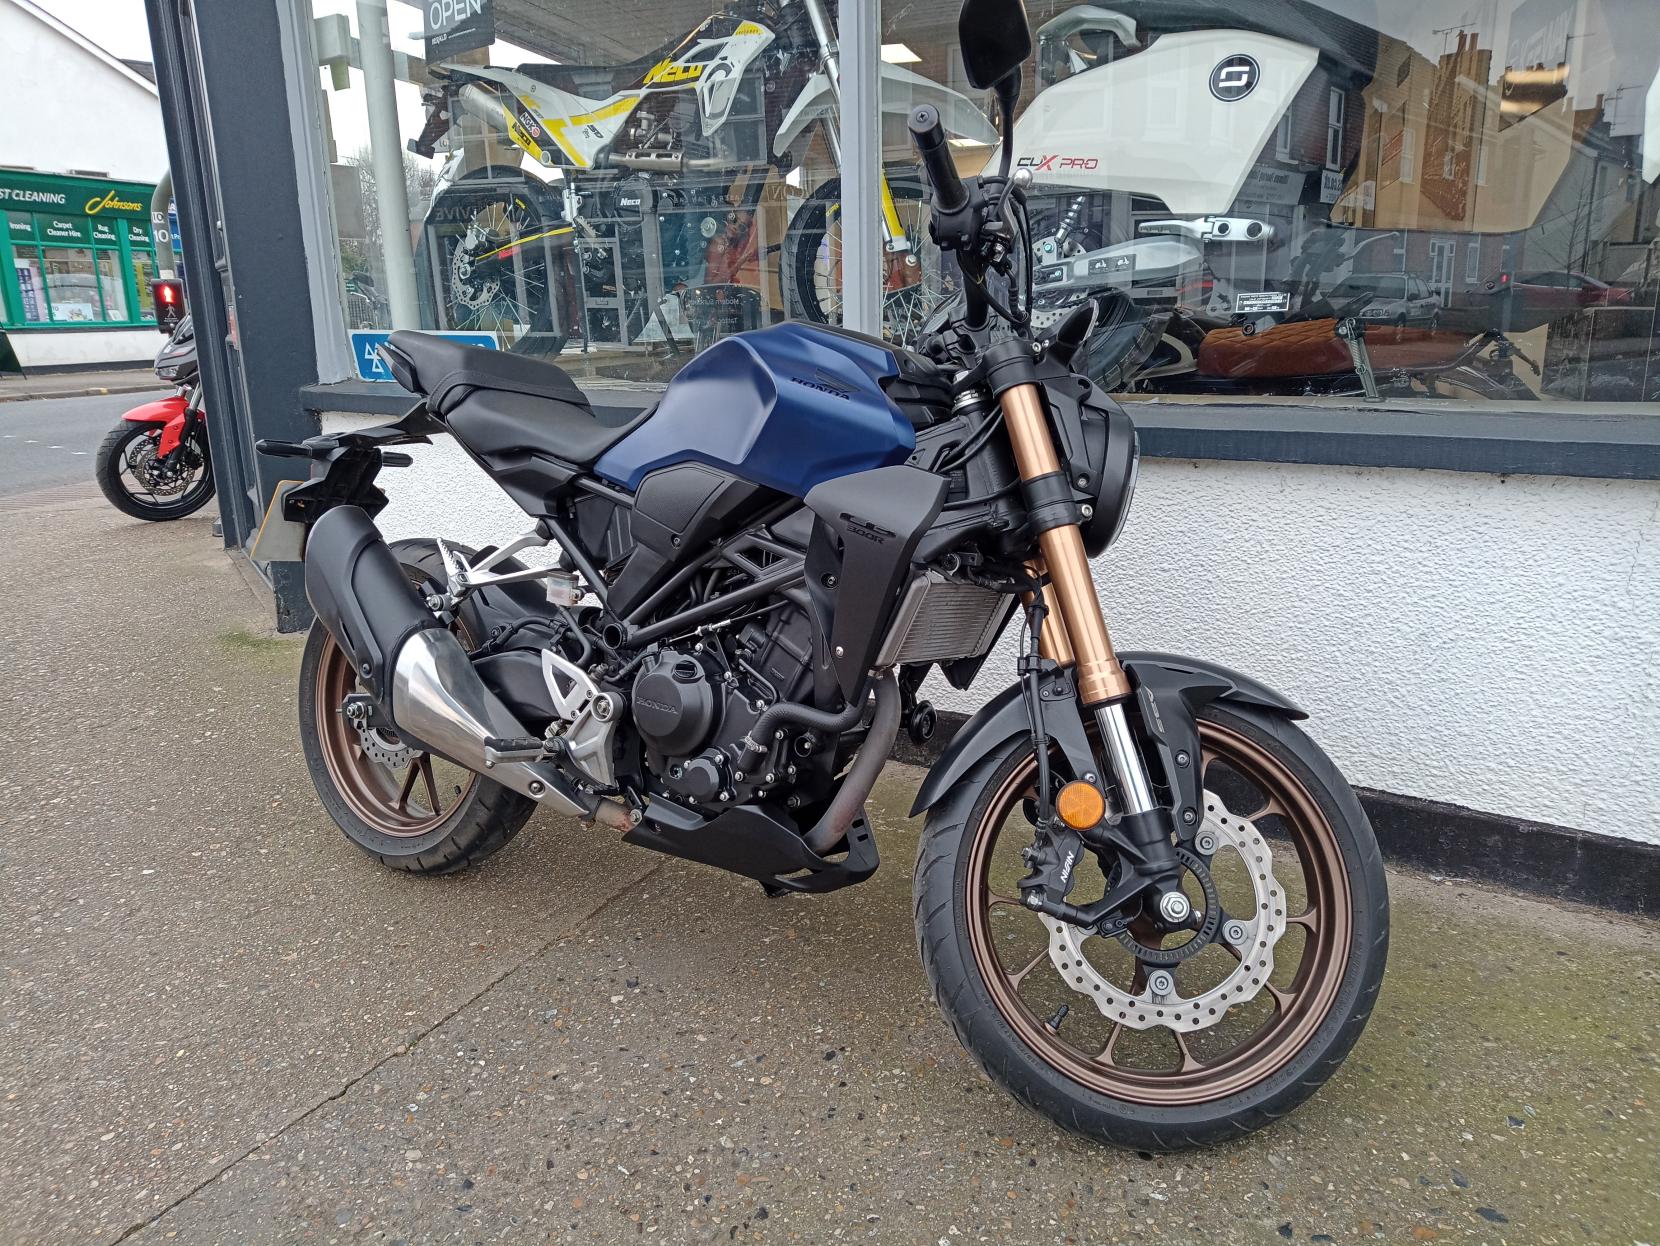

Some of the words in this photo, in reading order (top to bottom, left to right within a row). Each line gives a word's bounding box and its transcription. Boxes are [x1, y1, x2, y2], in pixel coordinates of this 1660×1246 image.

[430, 0, 482, 30] OPEN
[1060, 158, 1099, 170] PRO
[12, 190, 66, 204] CLEANING
[85, 190, 143, 214] Johnsons
[790, 377, 850, 401] HONDA
[636, 696, 679, 715] HONDA
